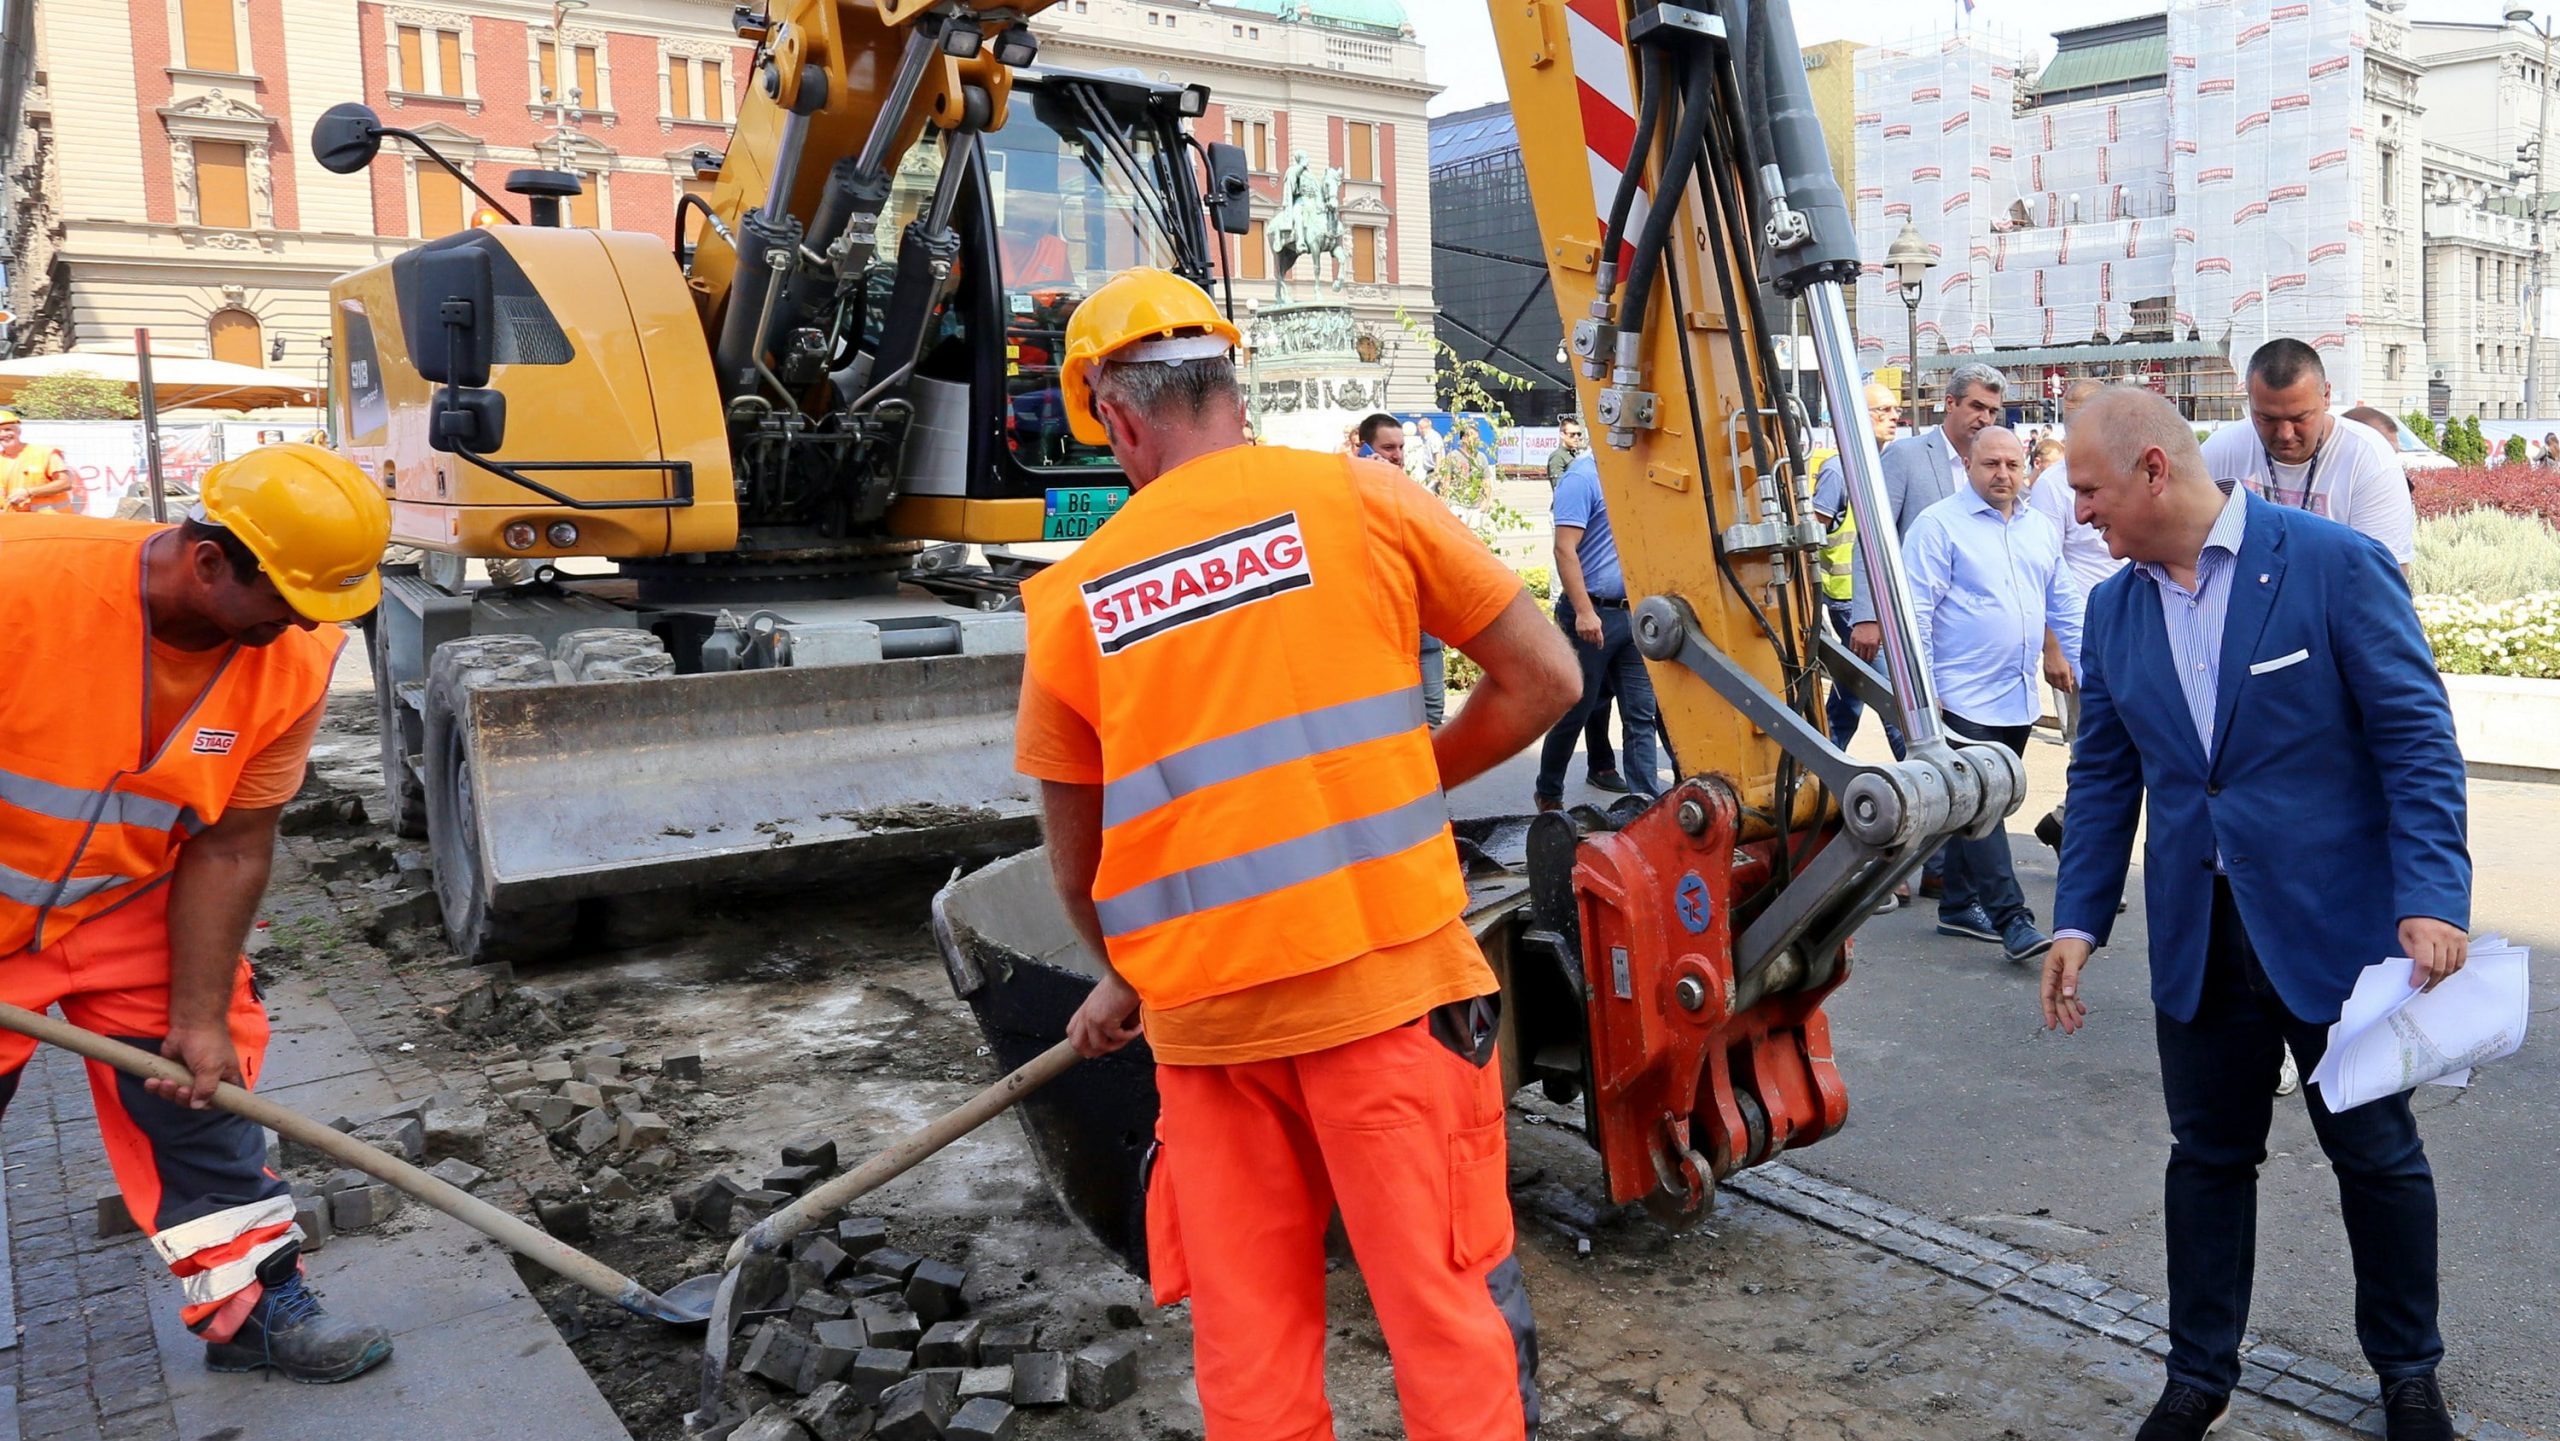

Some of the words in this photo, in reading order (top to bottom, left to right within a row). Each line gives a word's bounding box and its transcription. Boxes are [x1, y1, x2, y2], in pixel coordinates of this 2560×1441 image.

[1068, 493, 1091, 513] BG
[1092, 535, 1303, 634] STRABAG
[195, 736, 232, 748] STAG
